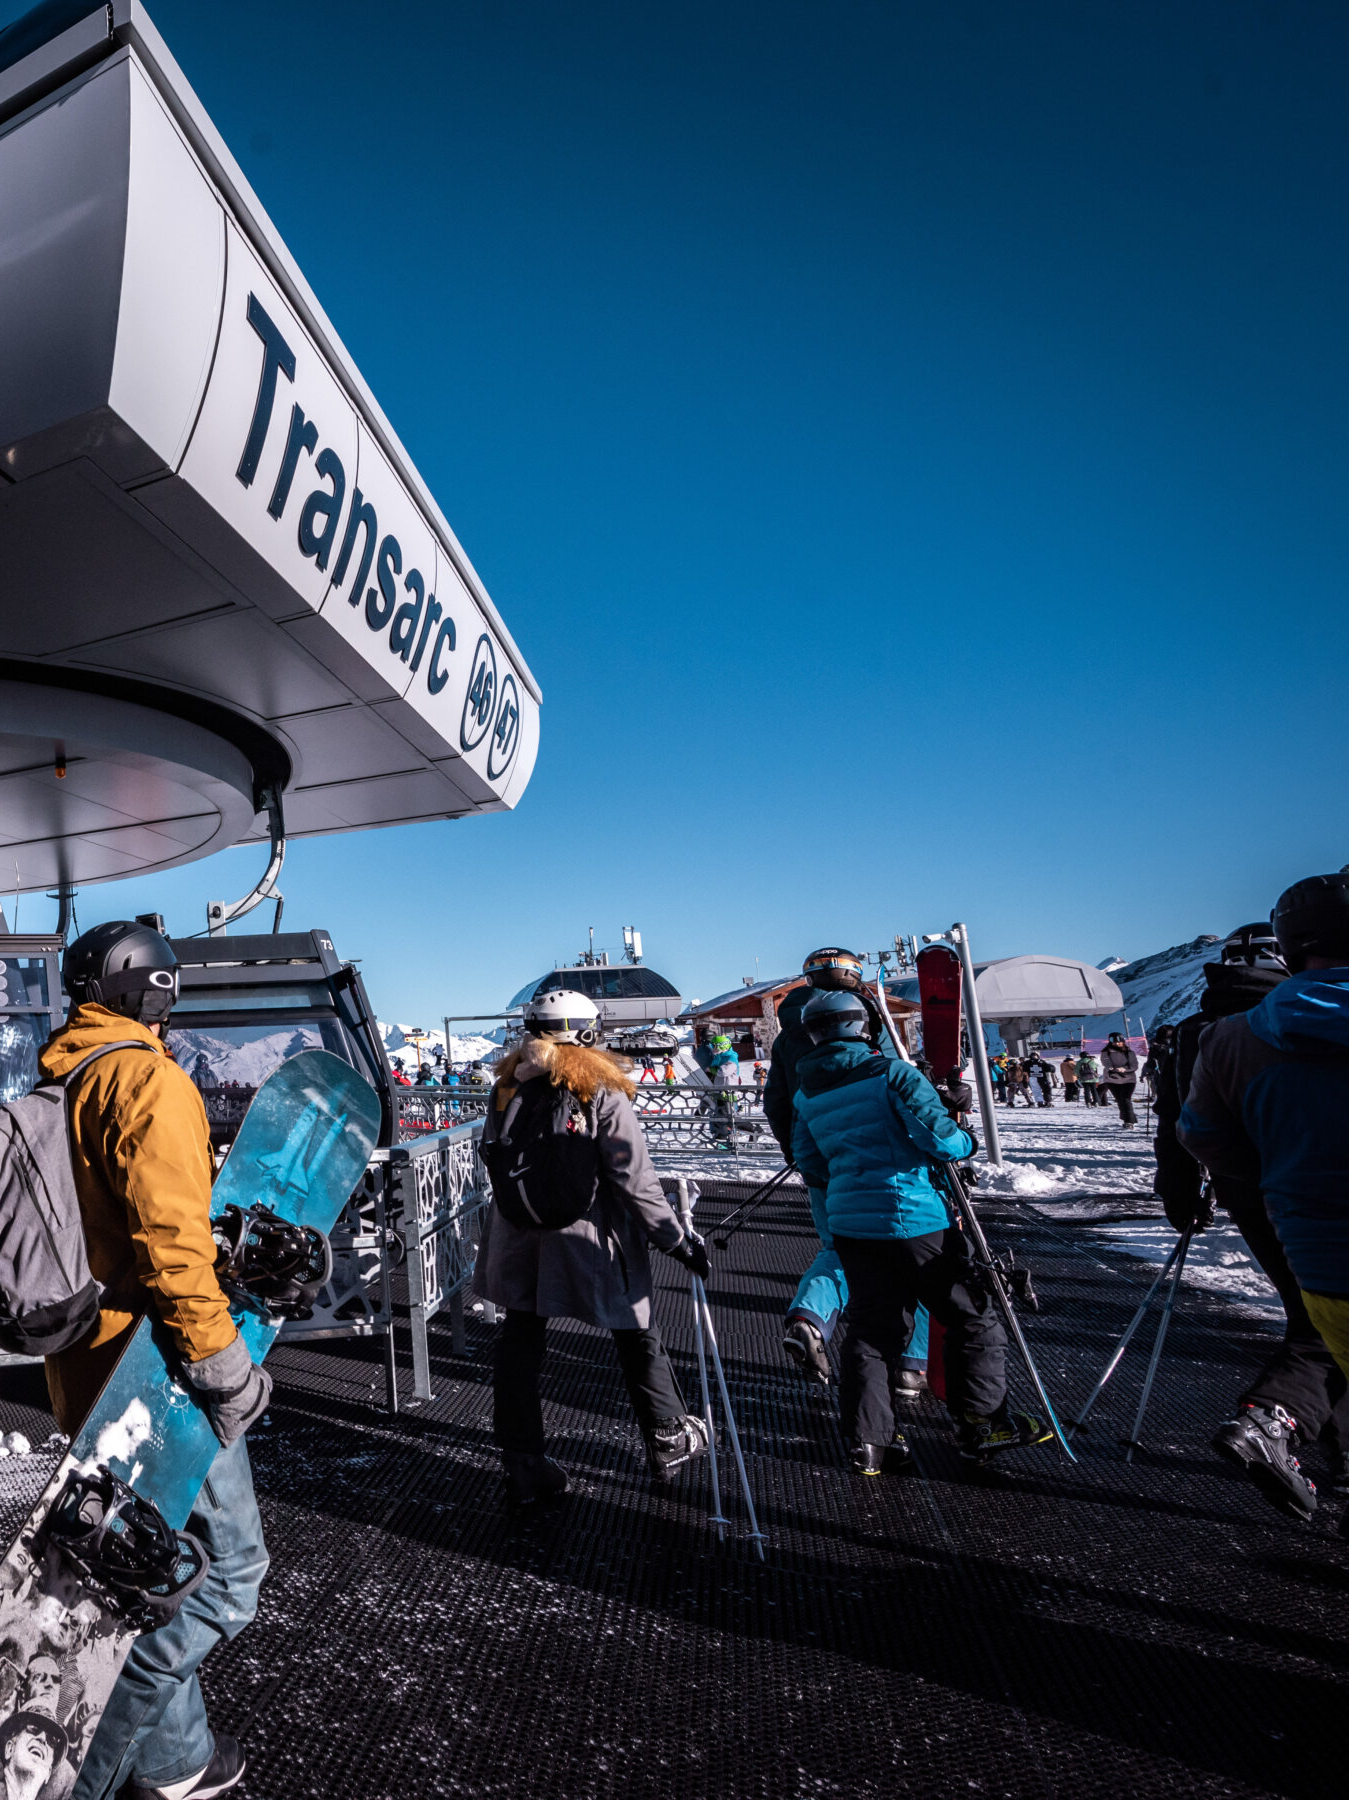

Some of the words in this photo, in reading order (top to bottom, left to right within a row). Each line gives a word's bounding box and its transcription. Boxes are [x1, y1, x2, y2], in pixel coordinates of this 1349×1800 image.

[236, 290, 456, 695] Transarc
[470, 660, 493, 727] 46
[496, 698, 518, 756] 47
[320, 939, 334, 951] 73
[665, 1454, 690, 1468] HEAD
